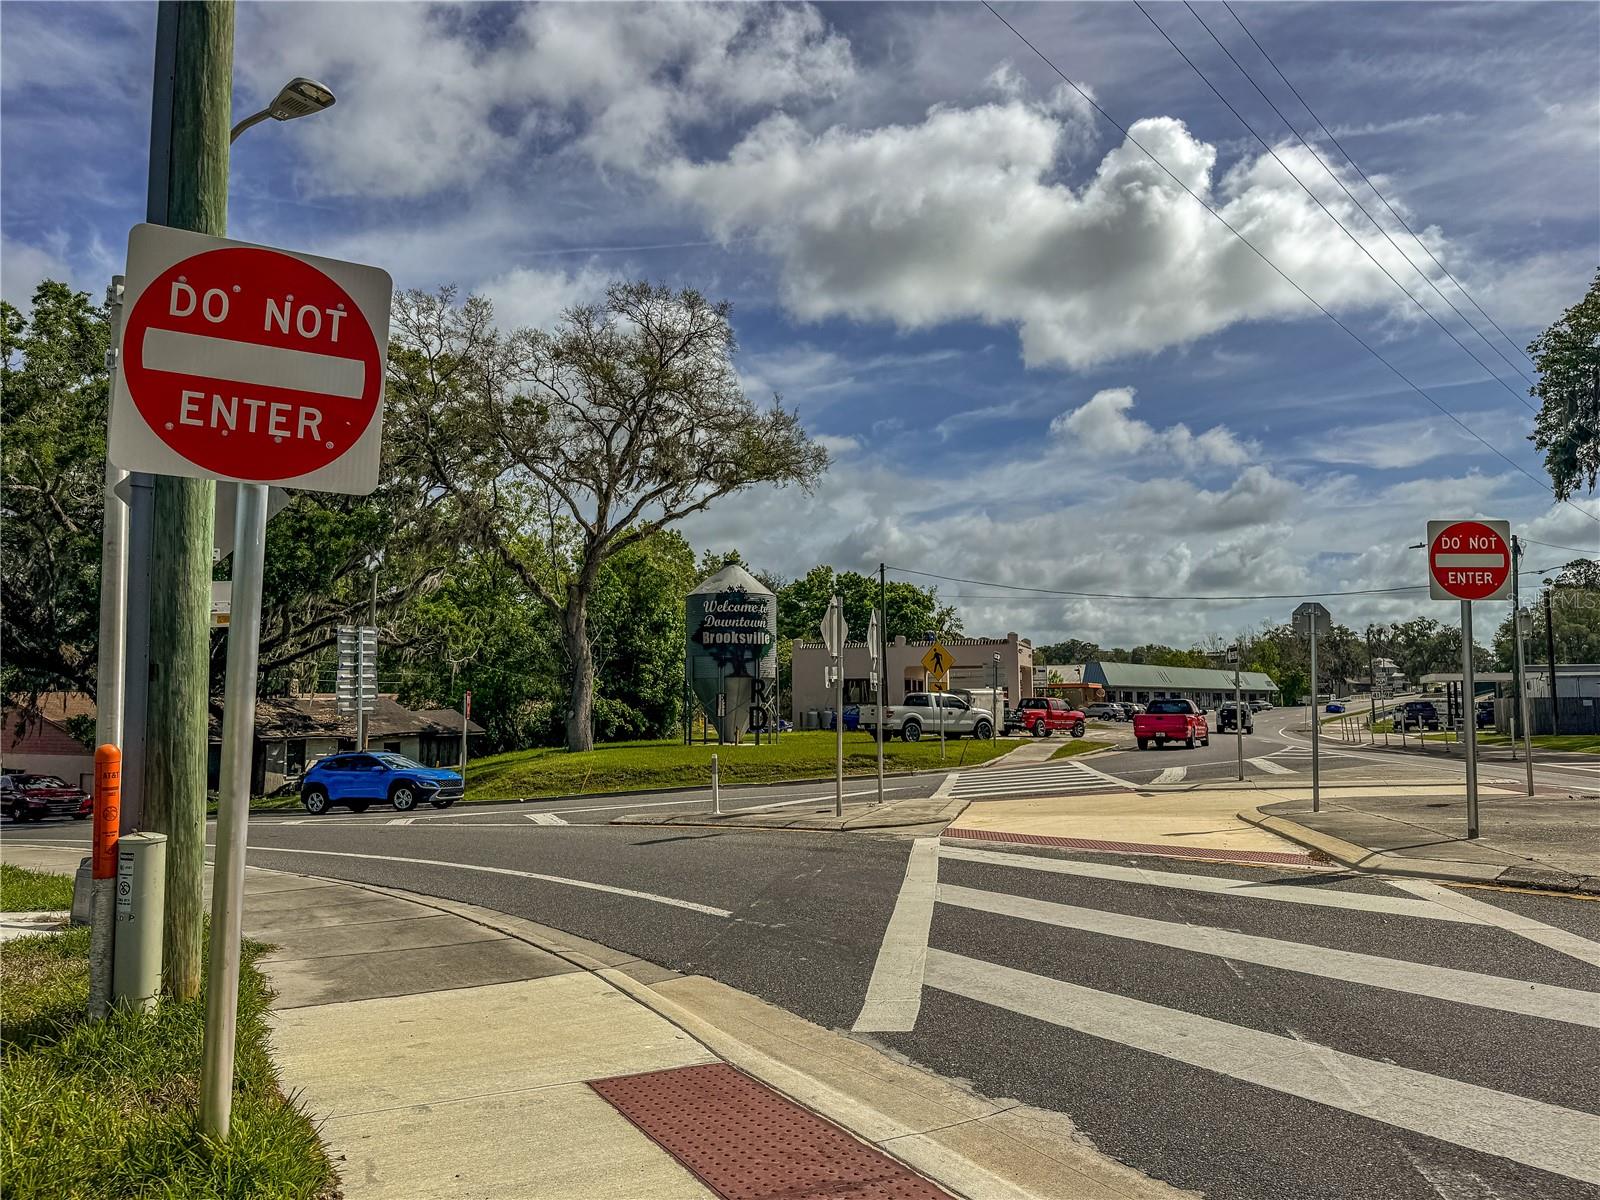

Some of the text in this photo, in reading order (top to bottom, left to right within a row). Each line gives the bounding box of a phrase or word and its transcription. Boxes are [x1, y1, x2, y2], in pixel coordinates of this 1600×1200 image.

[169, 281, 347, 342] DO NOT
[179, 390, 323, 441] ENTER
[1441, 537, 1497, 549] DO NOT
[1448, 572, 1493, 584] ENTER
[703, 600, 768, 613] Welcome to
[703, 615, 767, 628] Downtown
[703, 632, 770, 644] Brooksville
